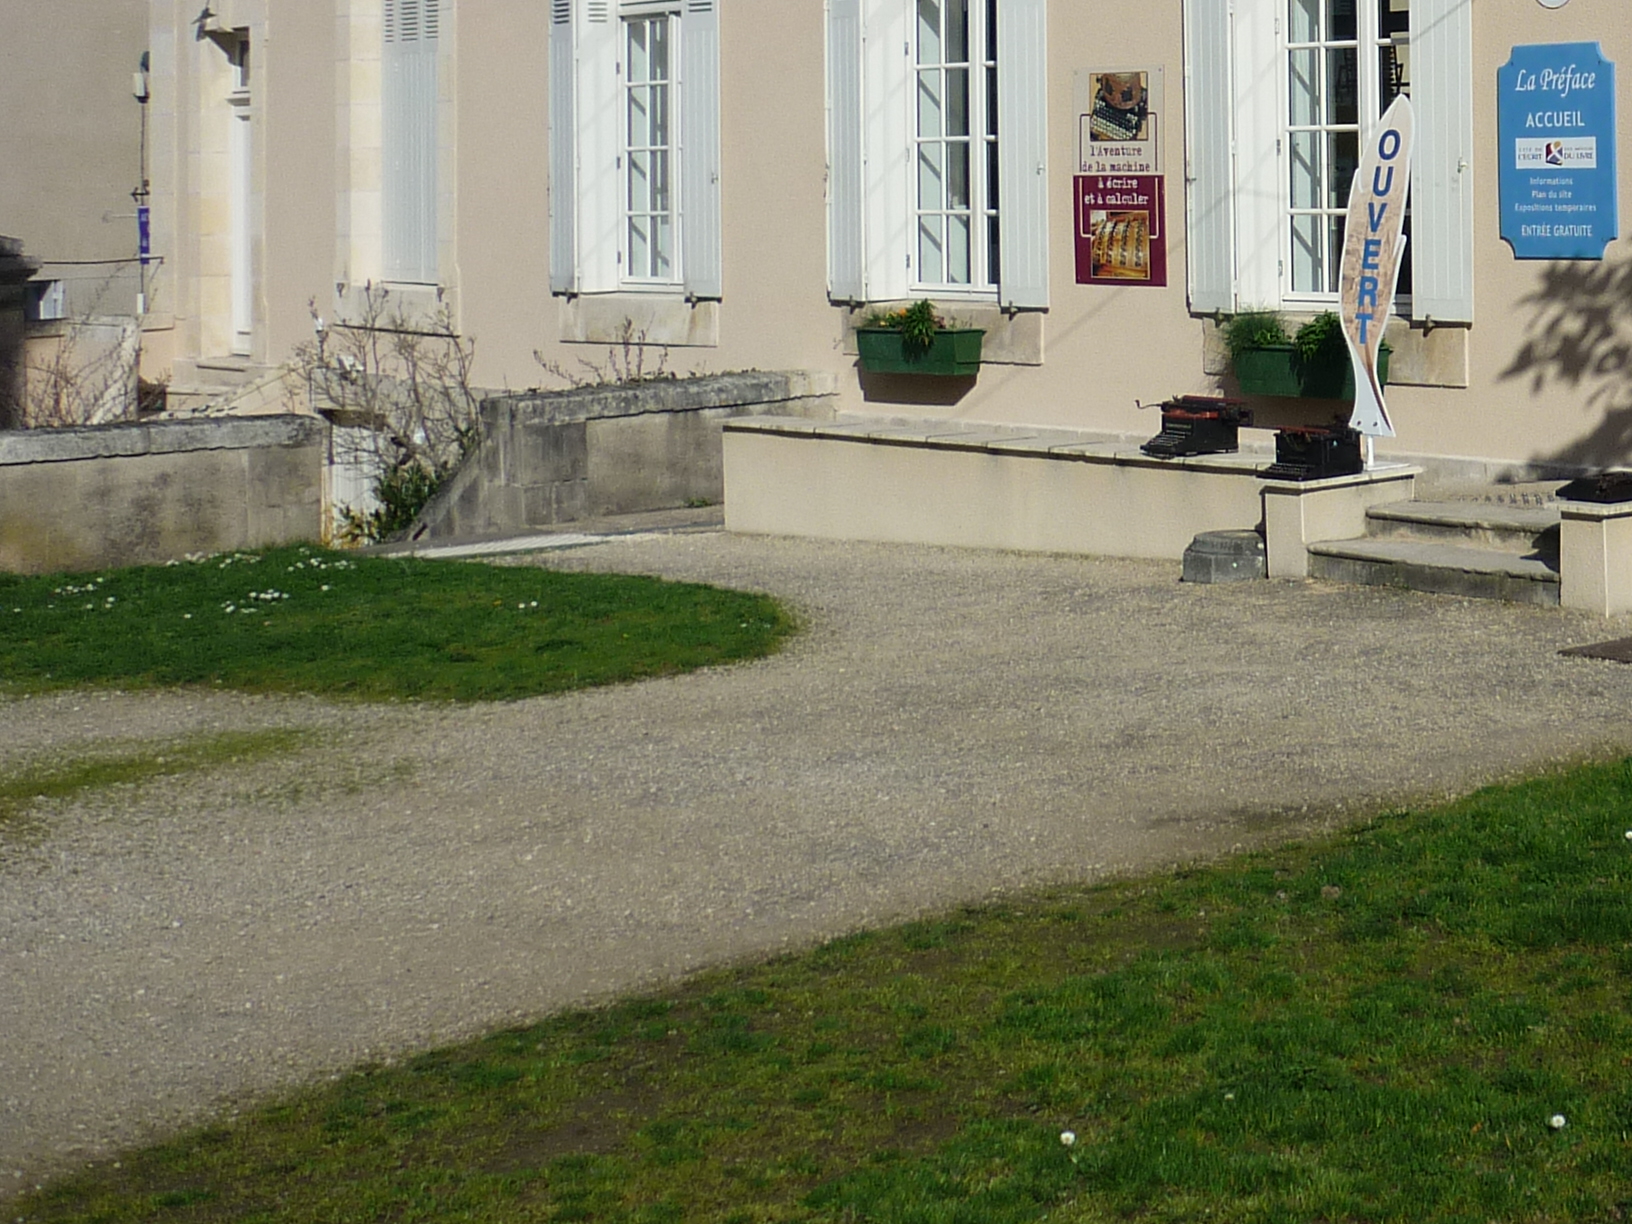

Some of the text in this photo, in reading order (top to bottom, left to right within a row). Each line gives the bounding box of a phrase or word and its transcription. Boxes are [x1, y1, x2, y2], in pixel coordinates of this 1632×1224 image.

[1515, 64, 1596, 98] La Préface
[1525, 111, 1585, 128] ACCUEIL
[1090, 145, 1142, 157] l'Aventure
[1082, 161, 1150, 172] de la machine
[1098, 177, 1138, 188] à écrire
[1530, 177, 1573, 185] Informations
[1084, 192, 1149, 204] et à calculer
[1532, 190, 1572, 199] Plan du site
[1515, 203, 1597, 213] Expositions temporaires
[1521, 222, 1592, 237] ENTRÉE GRATUITE
[1355, 129, 1402, 345] OUVERT
